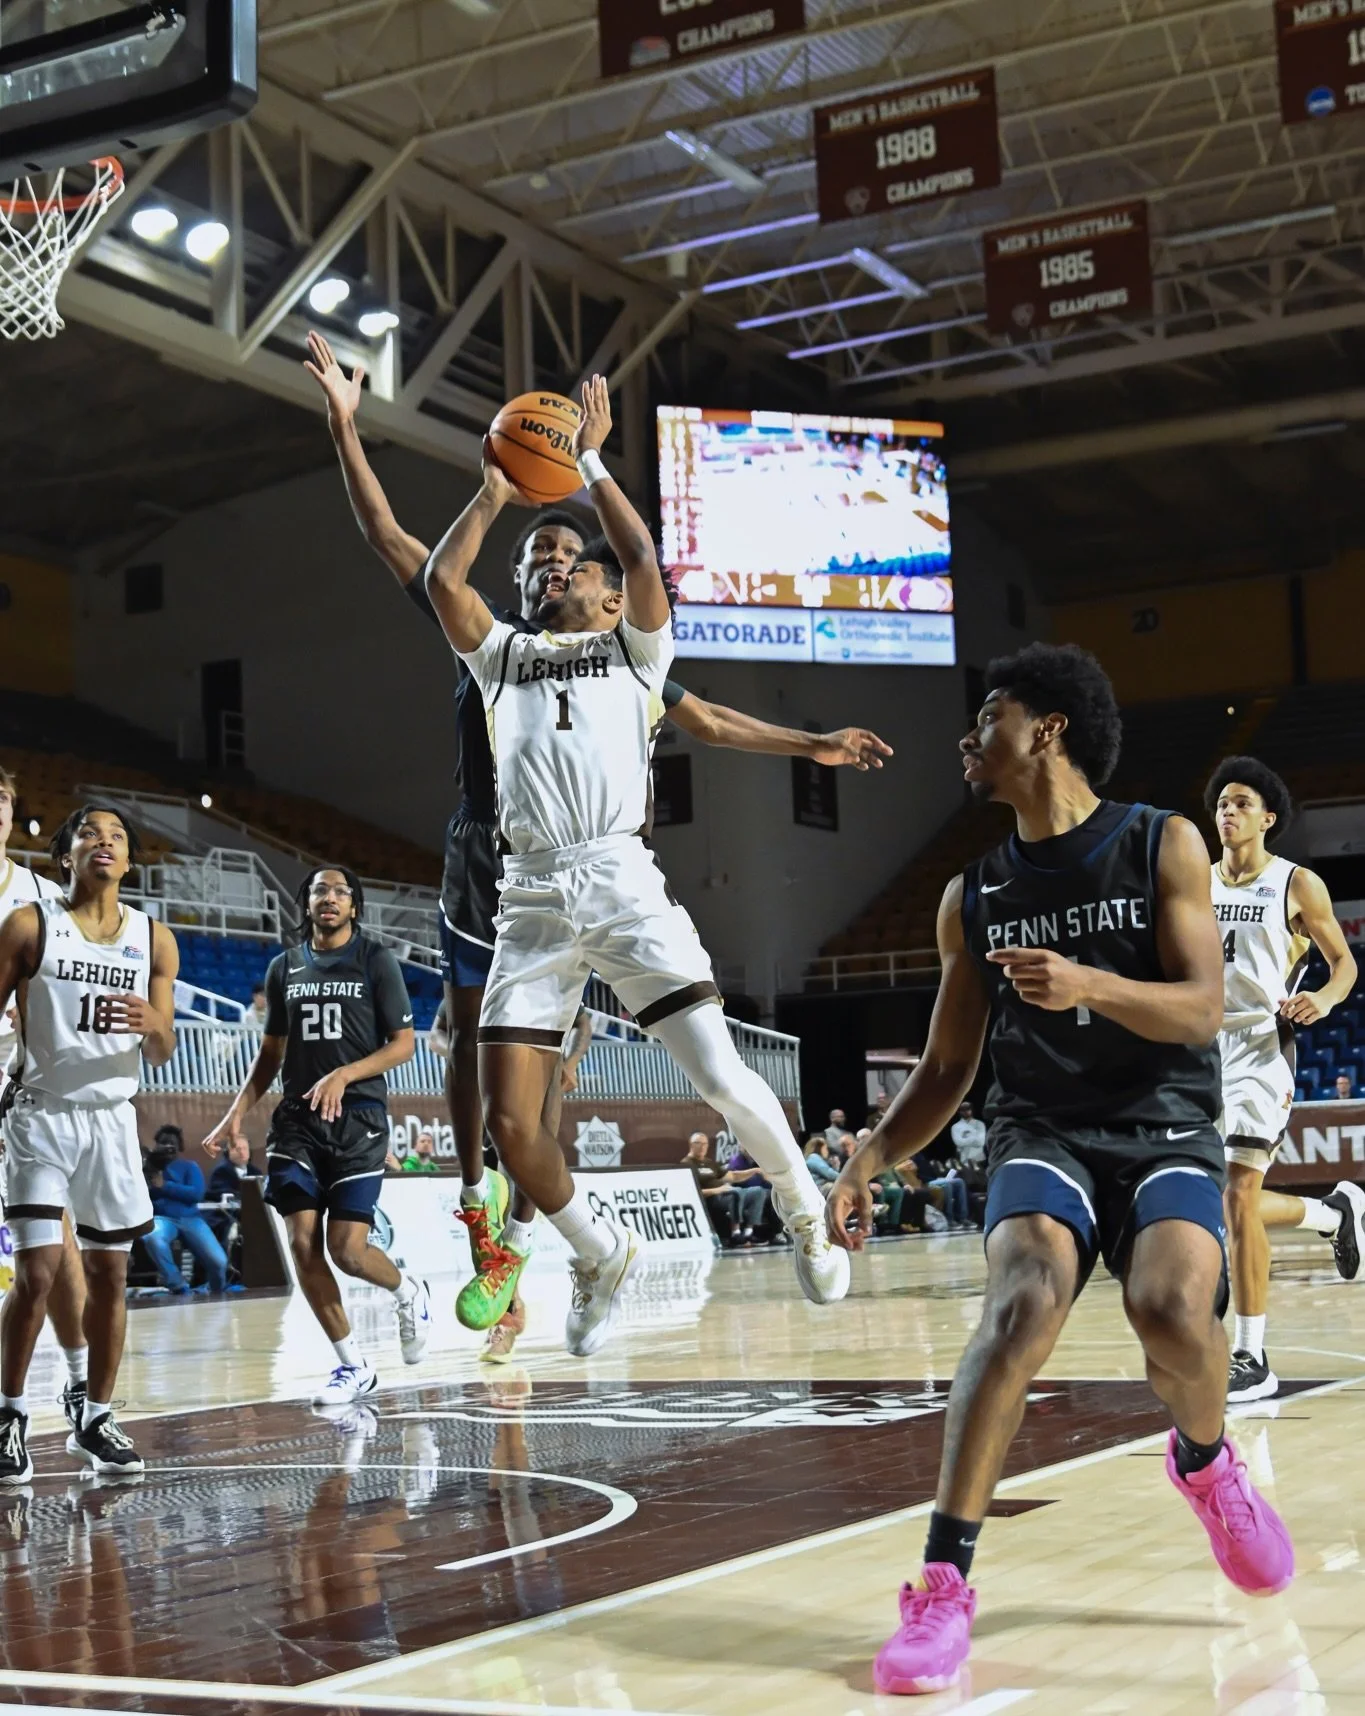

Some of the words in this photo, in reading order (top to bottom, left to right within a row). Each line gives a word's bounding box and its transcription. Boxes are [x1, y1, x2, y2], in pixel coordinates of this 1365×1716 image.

[677, 8, 775, 53] CHAMPIONS
[829, 104, 877, 132] MEN'S
[879, 81, 980, 122] BASKETBALL
[876, 124, 937, 169] 1988
[886, 166, 974, 204] CHAMPIONS
[997, 230, 1040, 253] MEN'S
[1042, 212, 1134, 247] BASKETBALL
[1039, 249, 1095, 289] 1985
[1049, 287, 1128, 319] CHAMPIONS
[673, 621, 806, 645] GATORADE
[516, 656, 609, 685] LEHIGH
[556, 689, 573, 730] 1
[986, 913, 1059, 951] PENN
[1066, 898, 1147, 938] STATE
[56, 959, 137, 990] LEHIGH
[286, 982, 320, 999] PENN
[322, 981, 364, 998] STATE
[301, 1002, 343, 1041] 20
[614, 1187, 668, 1205] HONEY
[619, 1203, 702, 1242] STINGER
